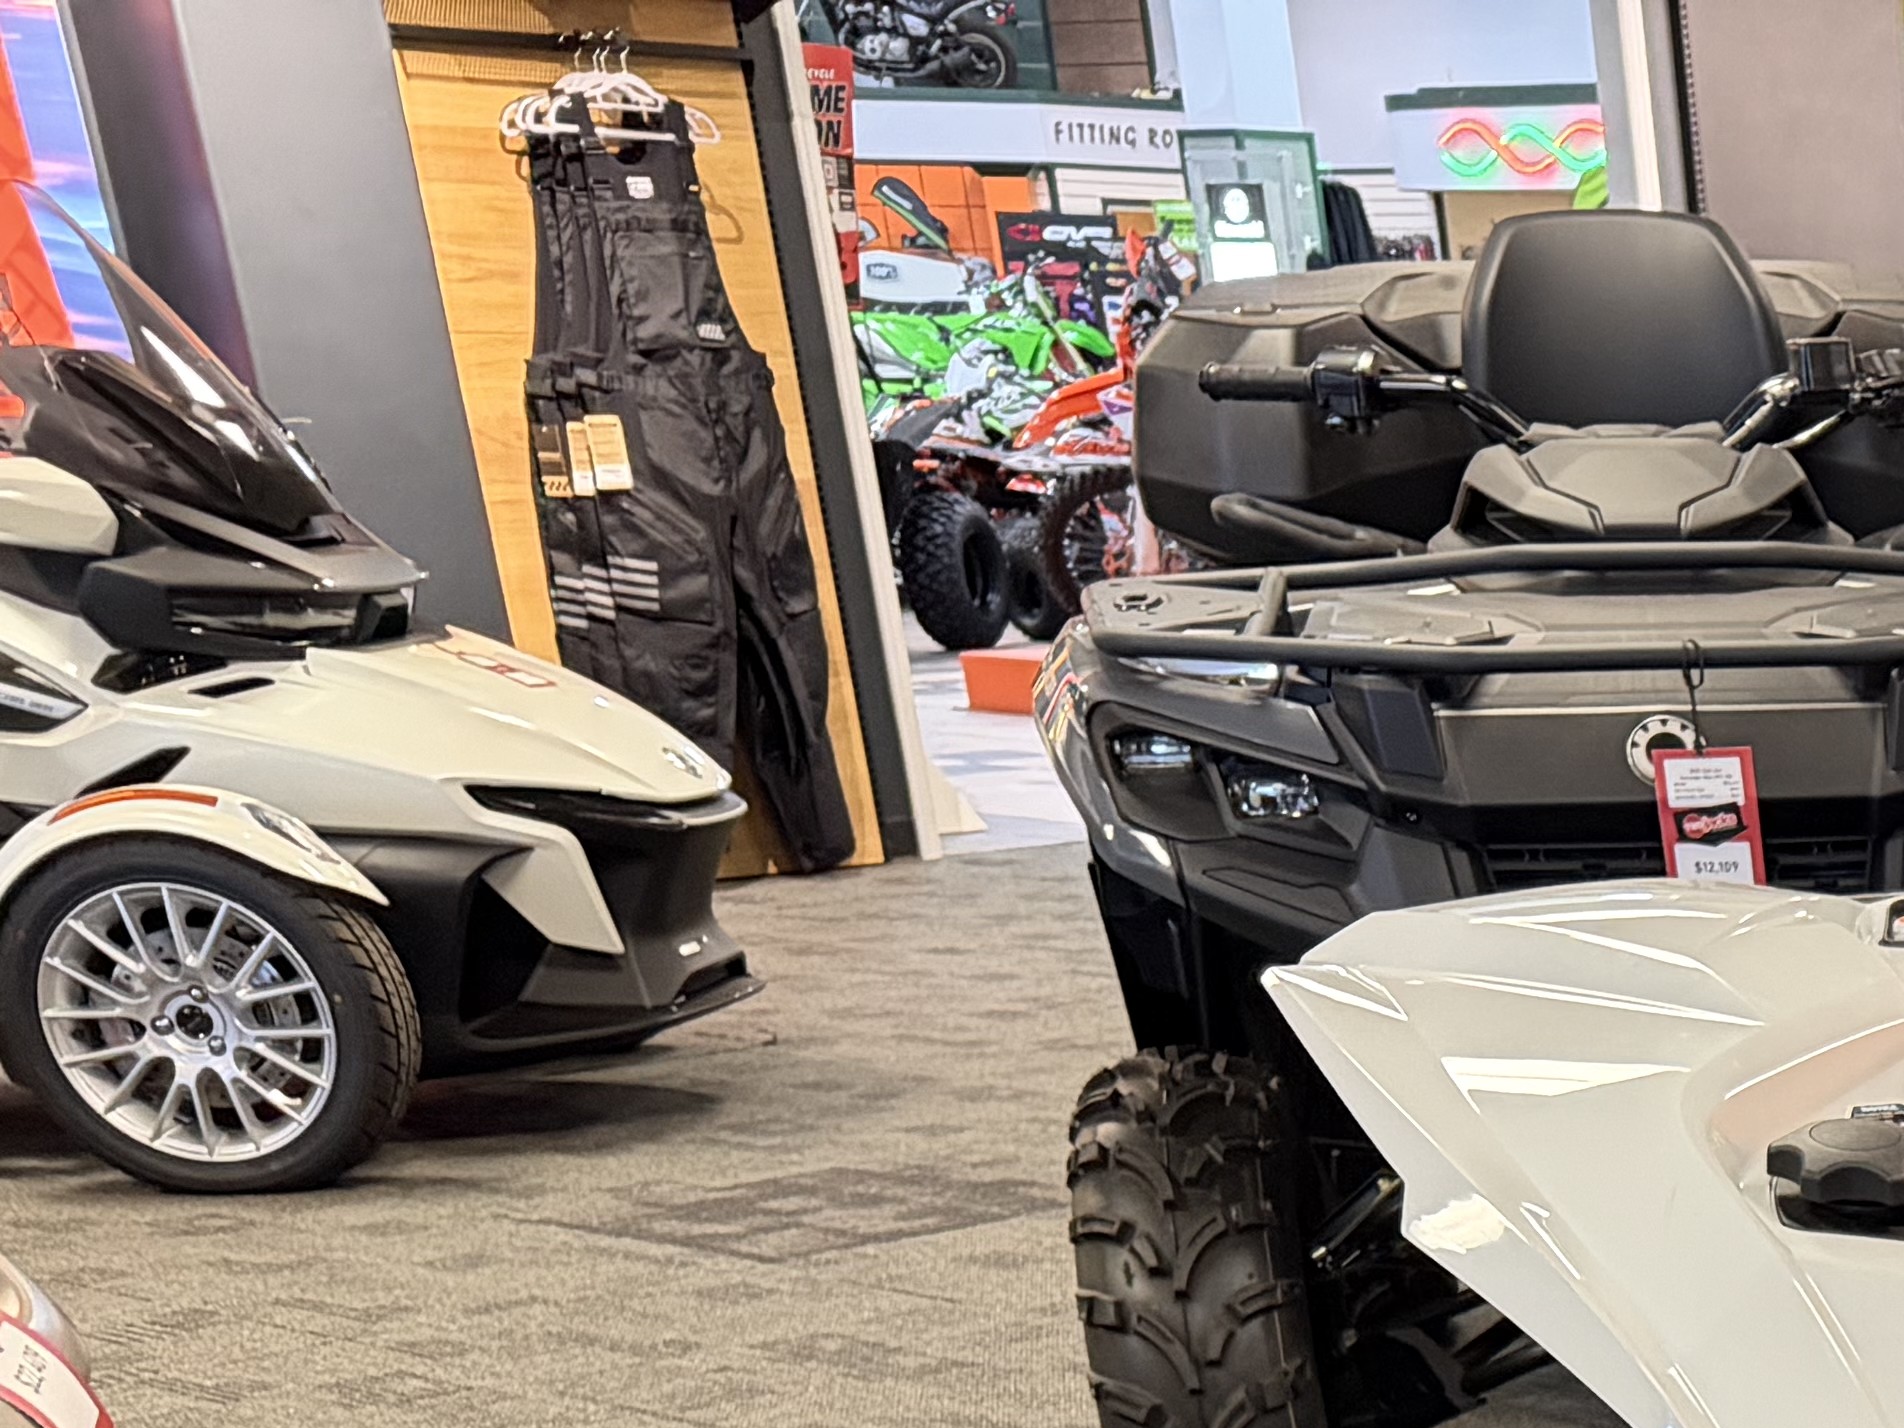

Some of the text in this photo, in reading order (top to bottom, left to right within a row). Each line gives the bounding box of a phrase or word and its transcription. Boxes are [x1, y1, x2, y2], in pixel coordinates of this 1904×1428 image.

[811, 84, 846, 115] ME
[1055, 120, 1174, 149] FITTING RO
[1694, 861, 1740, 874] $12,109
